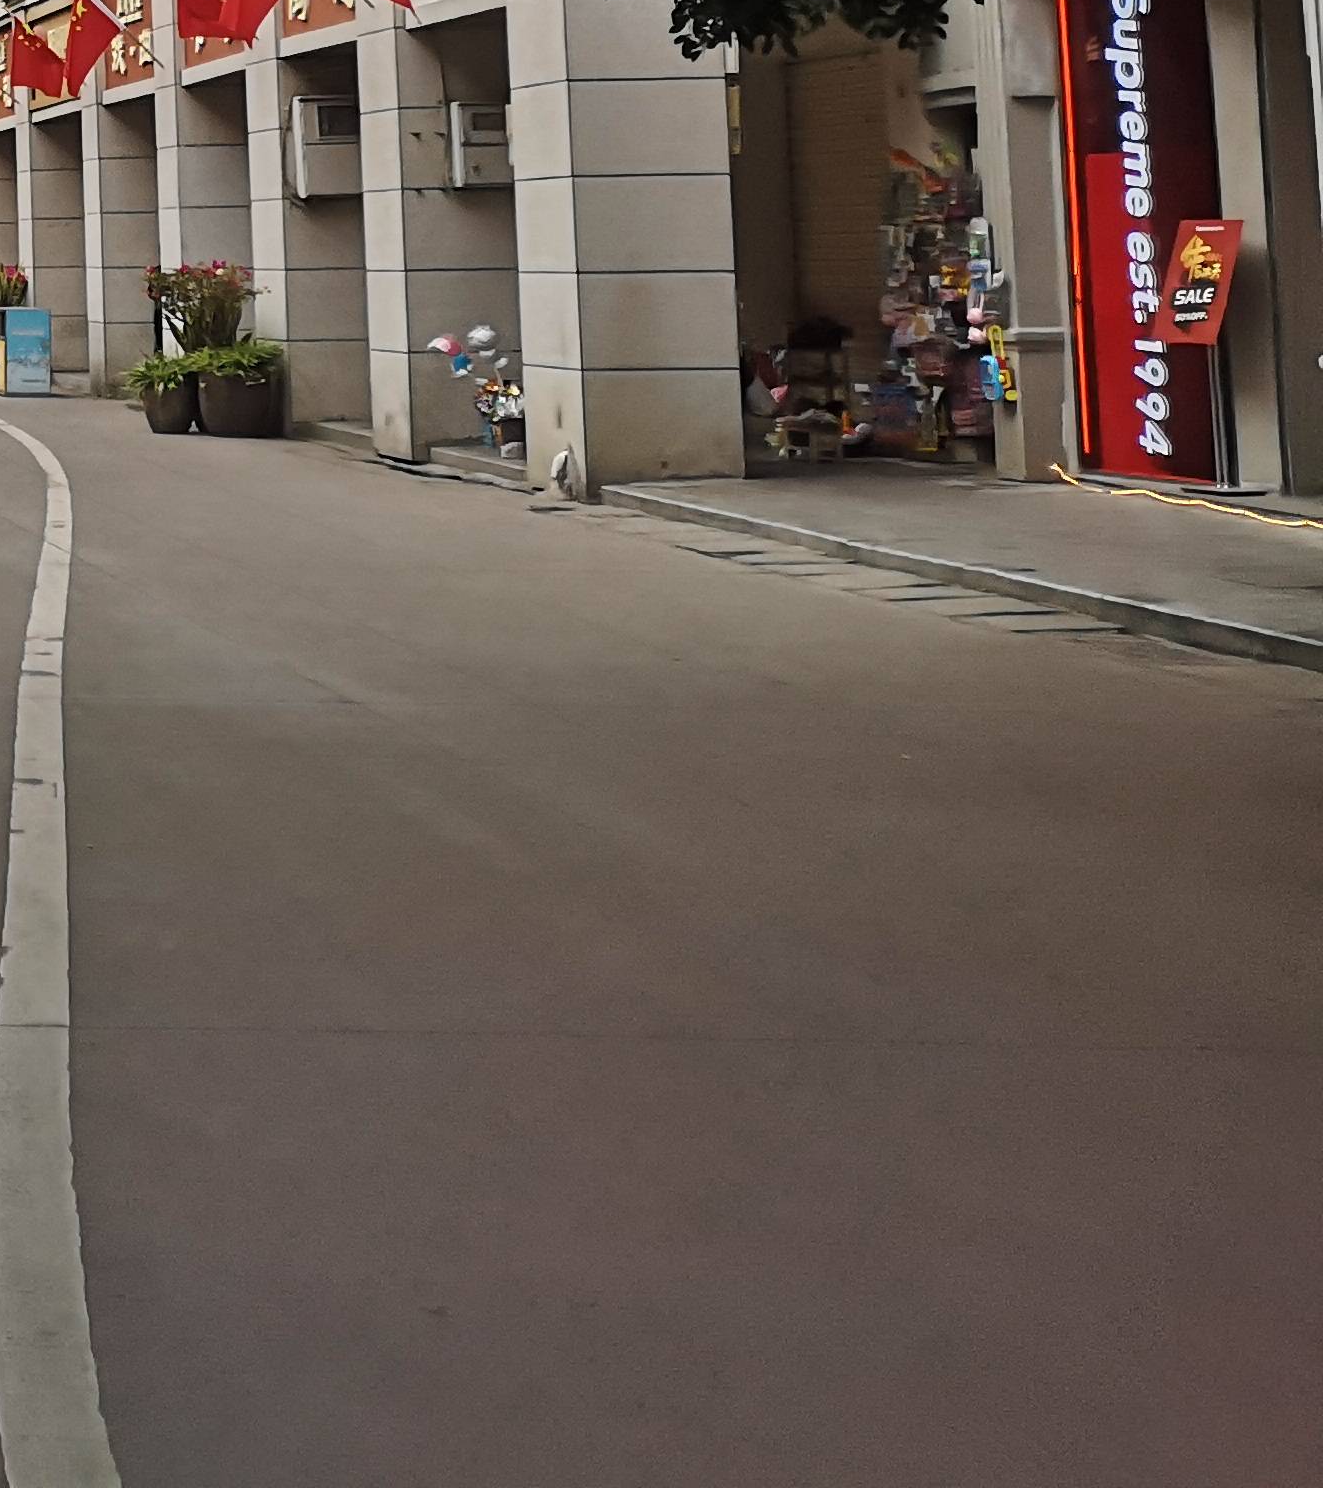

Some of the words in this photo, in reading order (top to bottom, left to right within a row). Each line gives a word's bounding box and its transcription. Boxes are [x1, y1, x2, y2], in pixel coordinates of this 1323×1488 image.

[1126, 231, 1159, 324] est.
[1174, 287, 1215, 306] SALE
[1133, 339, 1172, 456] 1994
